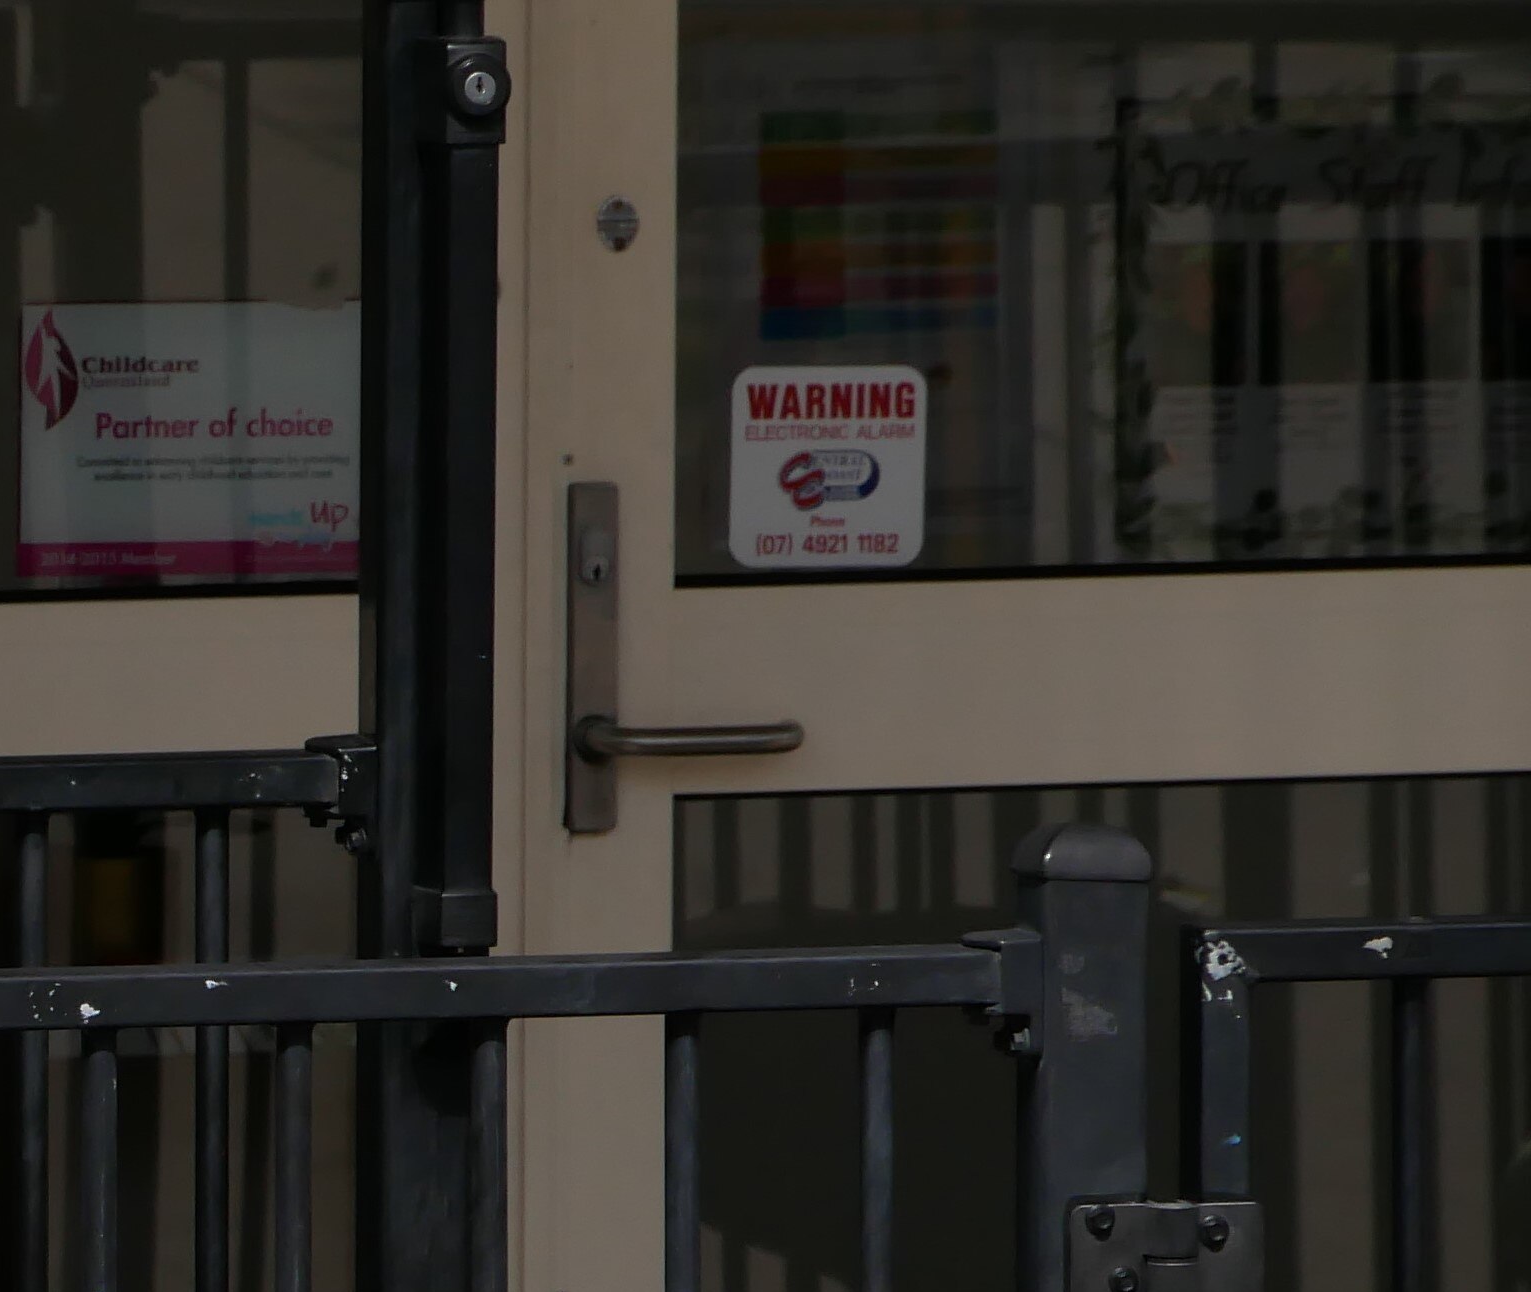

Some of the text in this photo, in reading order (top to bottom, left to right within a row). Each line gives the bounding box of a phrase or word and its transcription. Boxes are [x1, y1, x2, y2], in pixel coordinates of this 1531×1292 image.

[1165, 157, 1288, 211] Office
[1318, 155, 1438, 210] Staff
[80, 355, 200, 374] Childcare
[746, 382, 916, 420] WARNING
[95, 406, 335, 441] Partner of choice
[744, 423, 916, 441] ELECTRONIC ALARM
[755, 533, 900, 556] (07) 4921 1182
